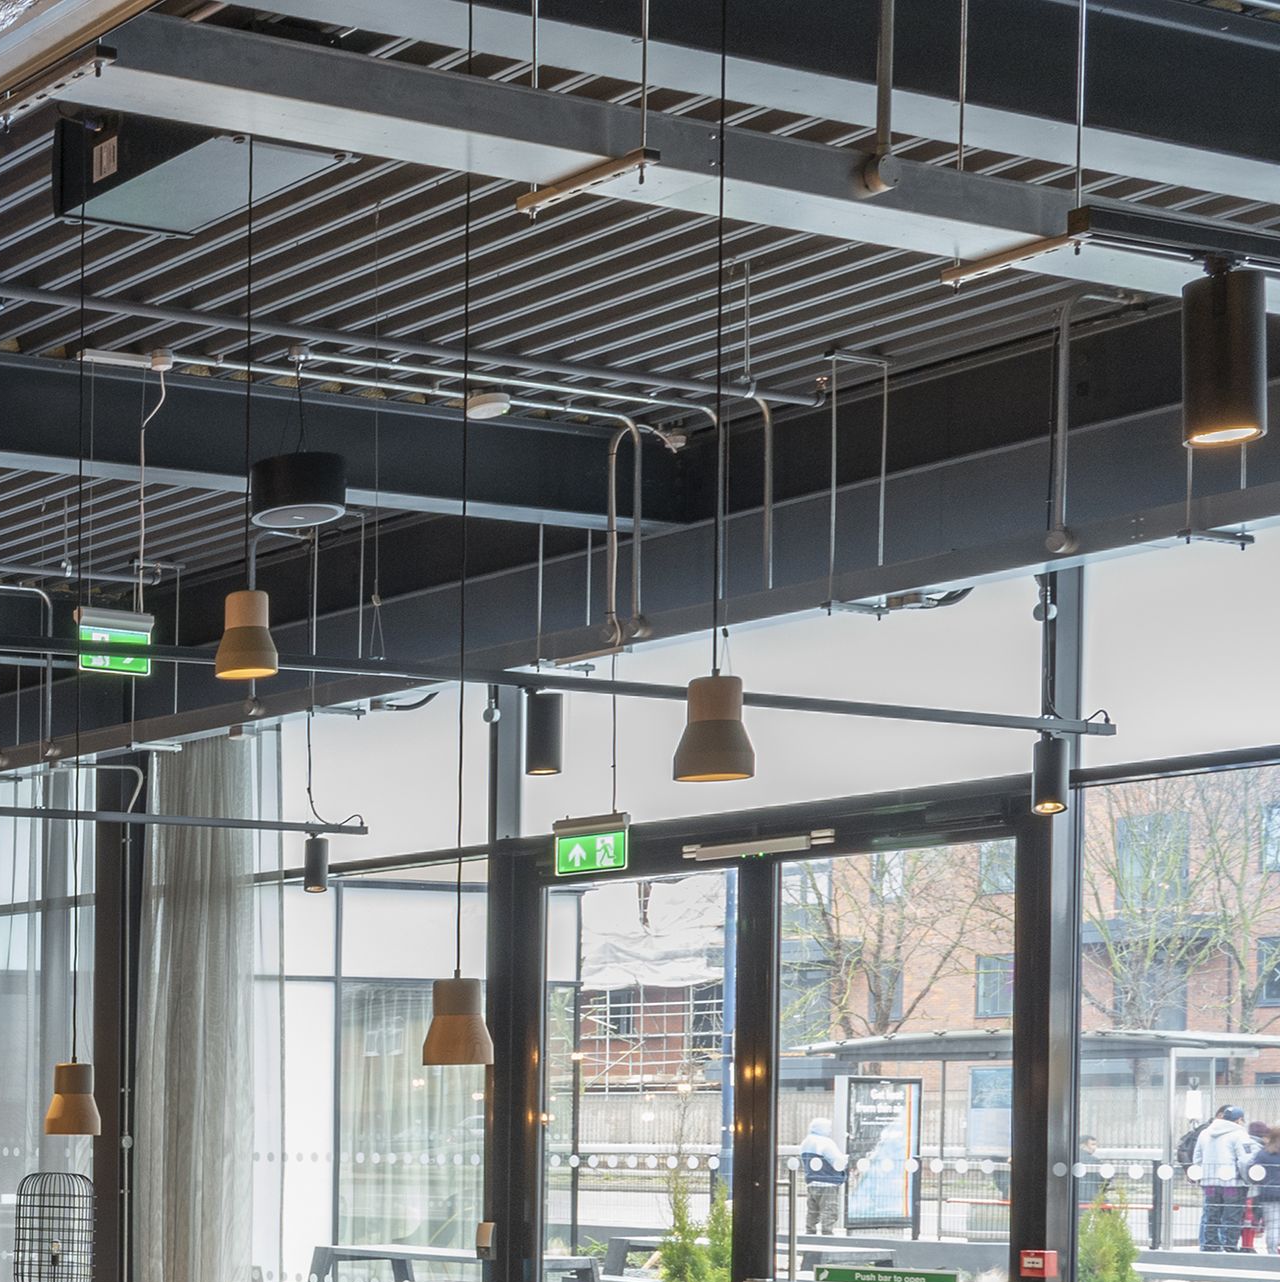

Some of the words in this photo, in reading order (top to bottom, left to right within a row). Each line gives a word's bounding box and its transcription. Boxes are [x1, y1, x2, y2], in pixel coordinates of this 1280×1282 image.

[855, 1272, 876, 1281] Push
[878, 1273, 892, 1282] bar
[893, 1275, 902, 1282] to
